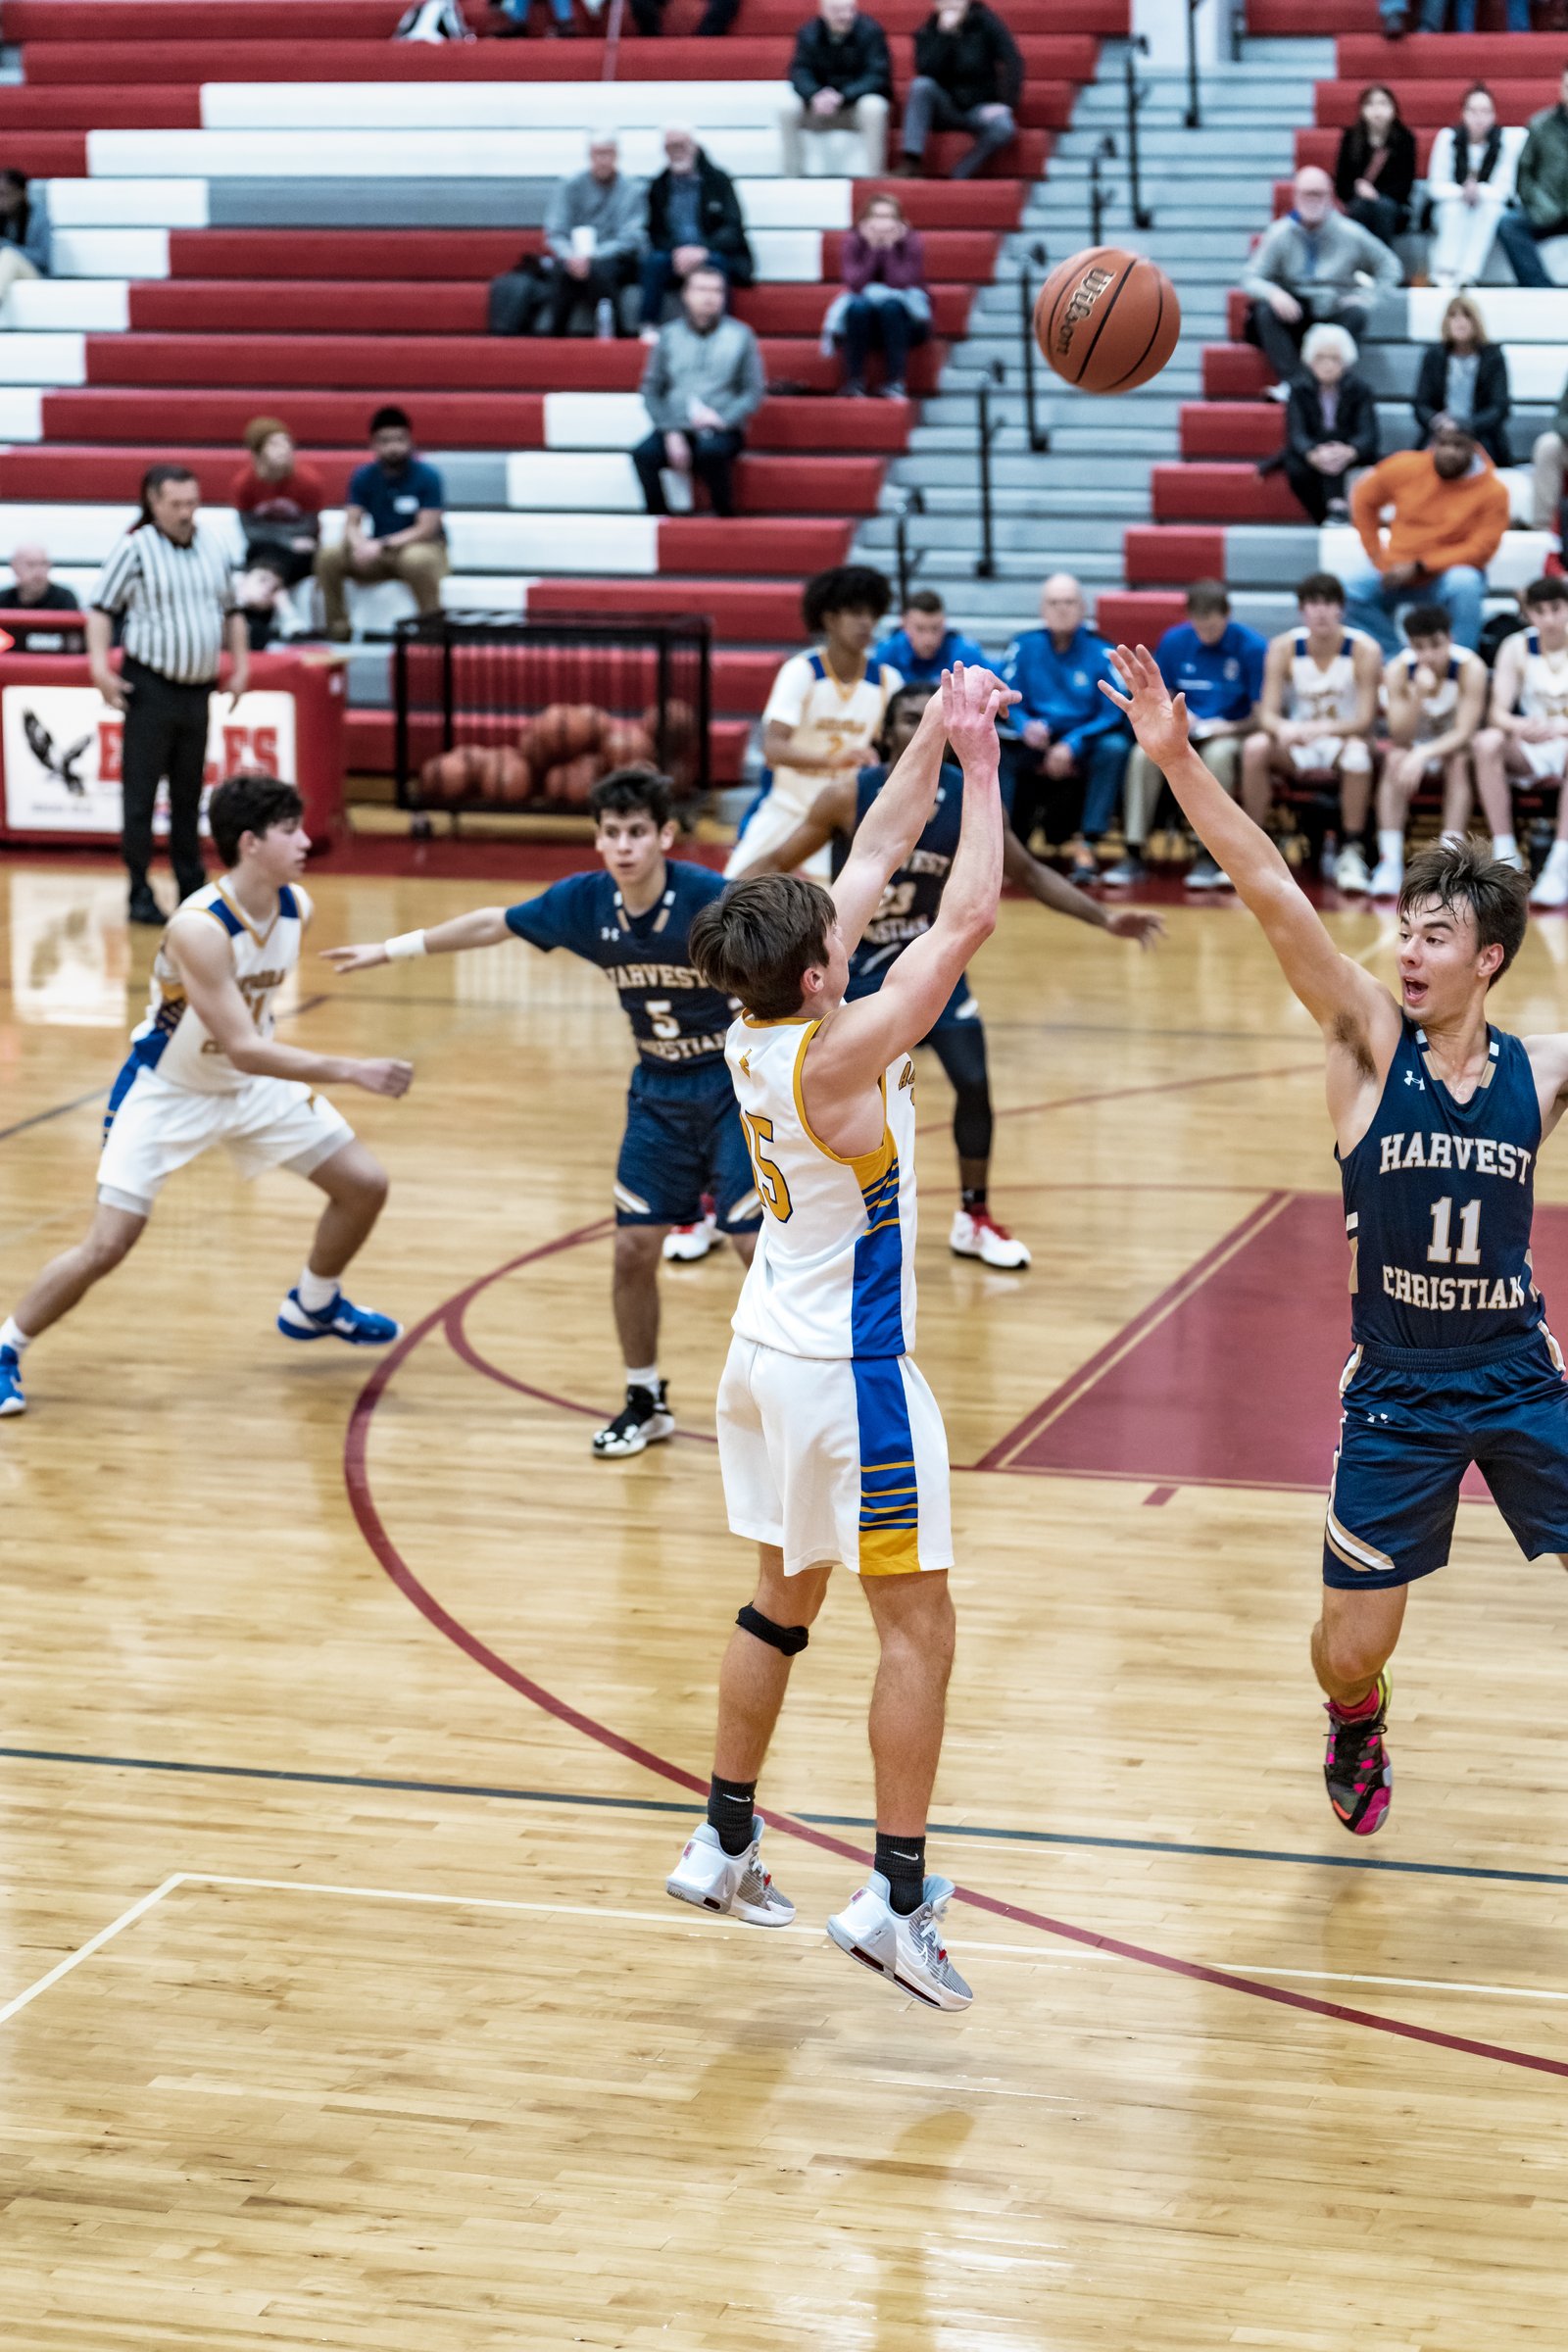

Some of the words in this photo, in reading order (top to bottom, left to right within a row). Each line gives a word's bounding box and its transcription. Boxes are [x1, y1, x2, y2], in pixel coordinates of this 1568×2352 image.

[1055, 266, 1117, 357] Wilson
[645, 1000, 680, 1039] 5
[1379, 1131, 1532, 1185] HARVEST
[1427, 1196, 1482, 1265] 11
[1382, 1263, 1525, 1311] CHRISTIAN
